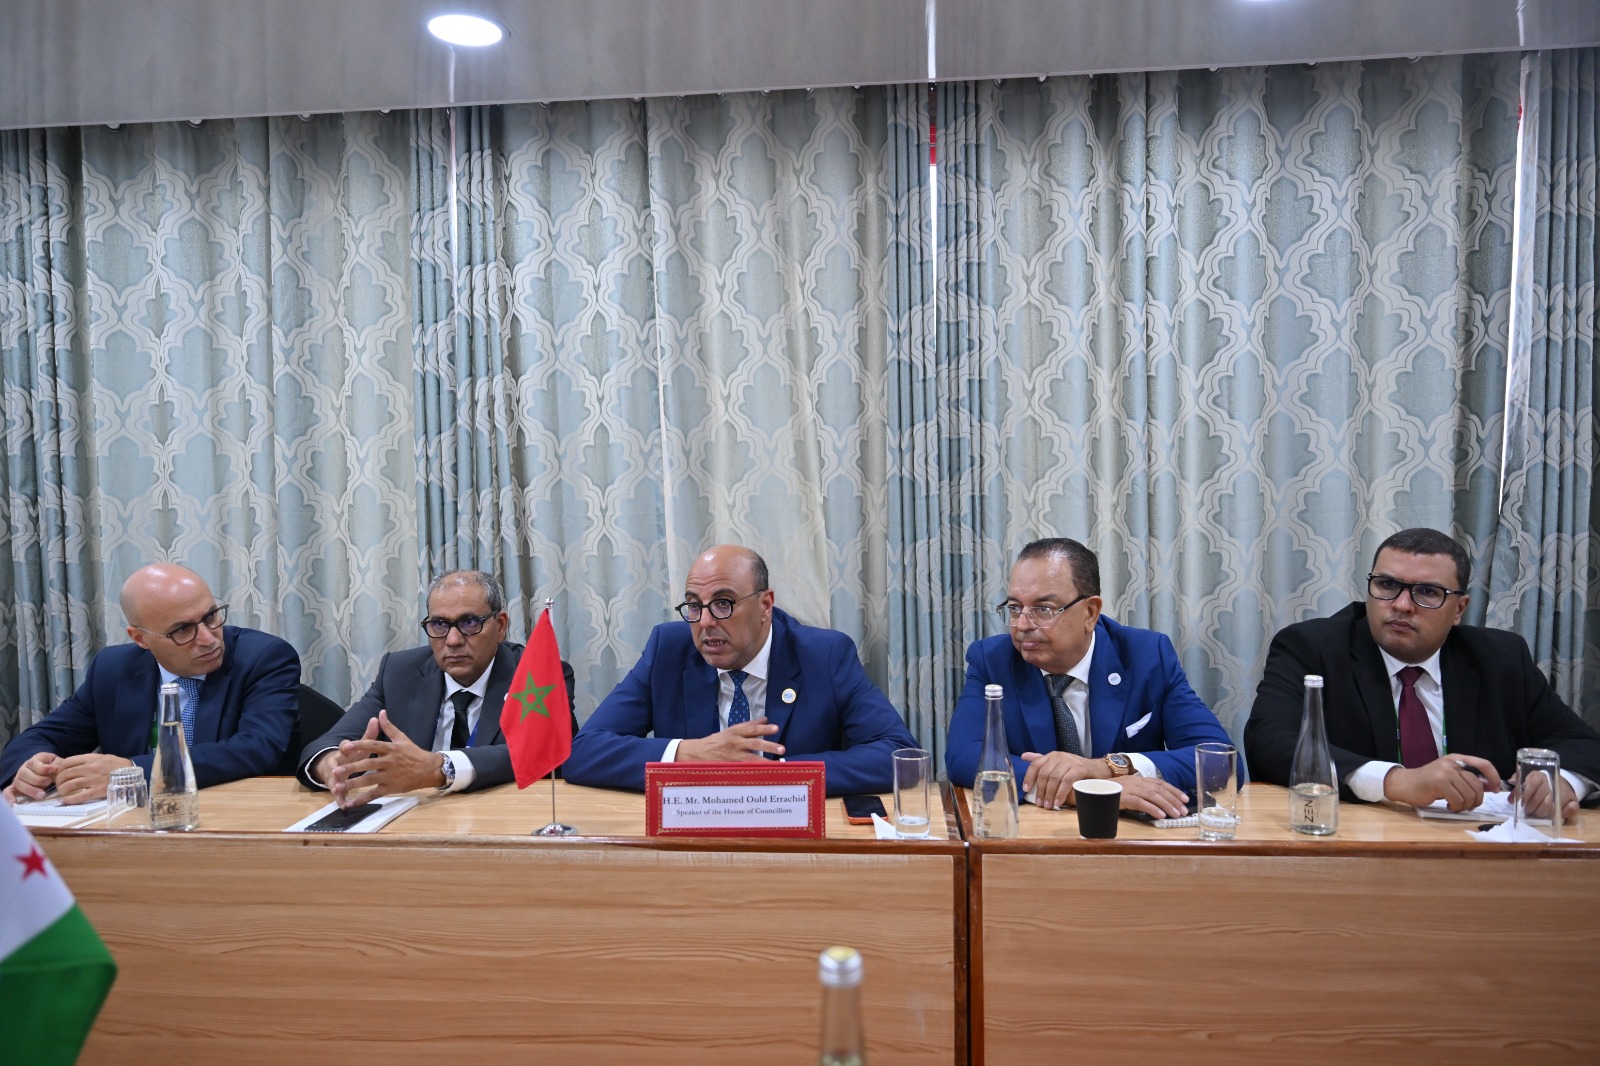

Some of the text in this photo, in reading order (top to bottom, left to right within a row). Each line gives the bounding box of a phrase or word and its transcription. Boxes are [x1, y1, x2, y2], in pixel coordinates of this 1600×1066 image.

[663, 794, 806, 805] H.E. Mr. Mohamed Ould Errachid
[676, 808, 702, 817] Speaker
[1304, 799, 1314, 823] ZEN
